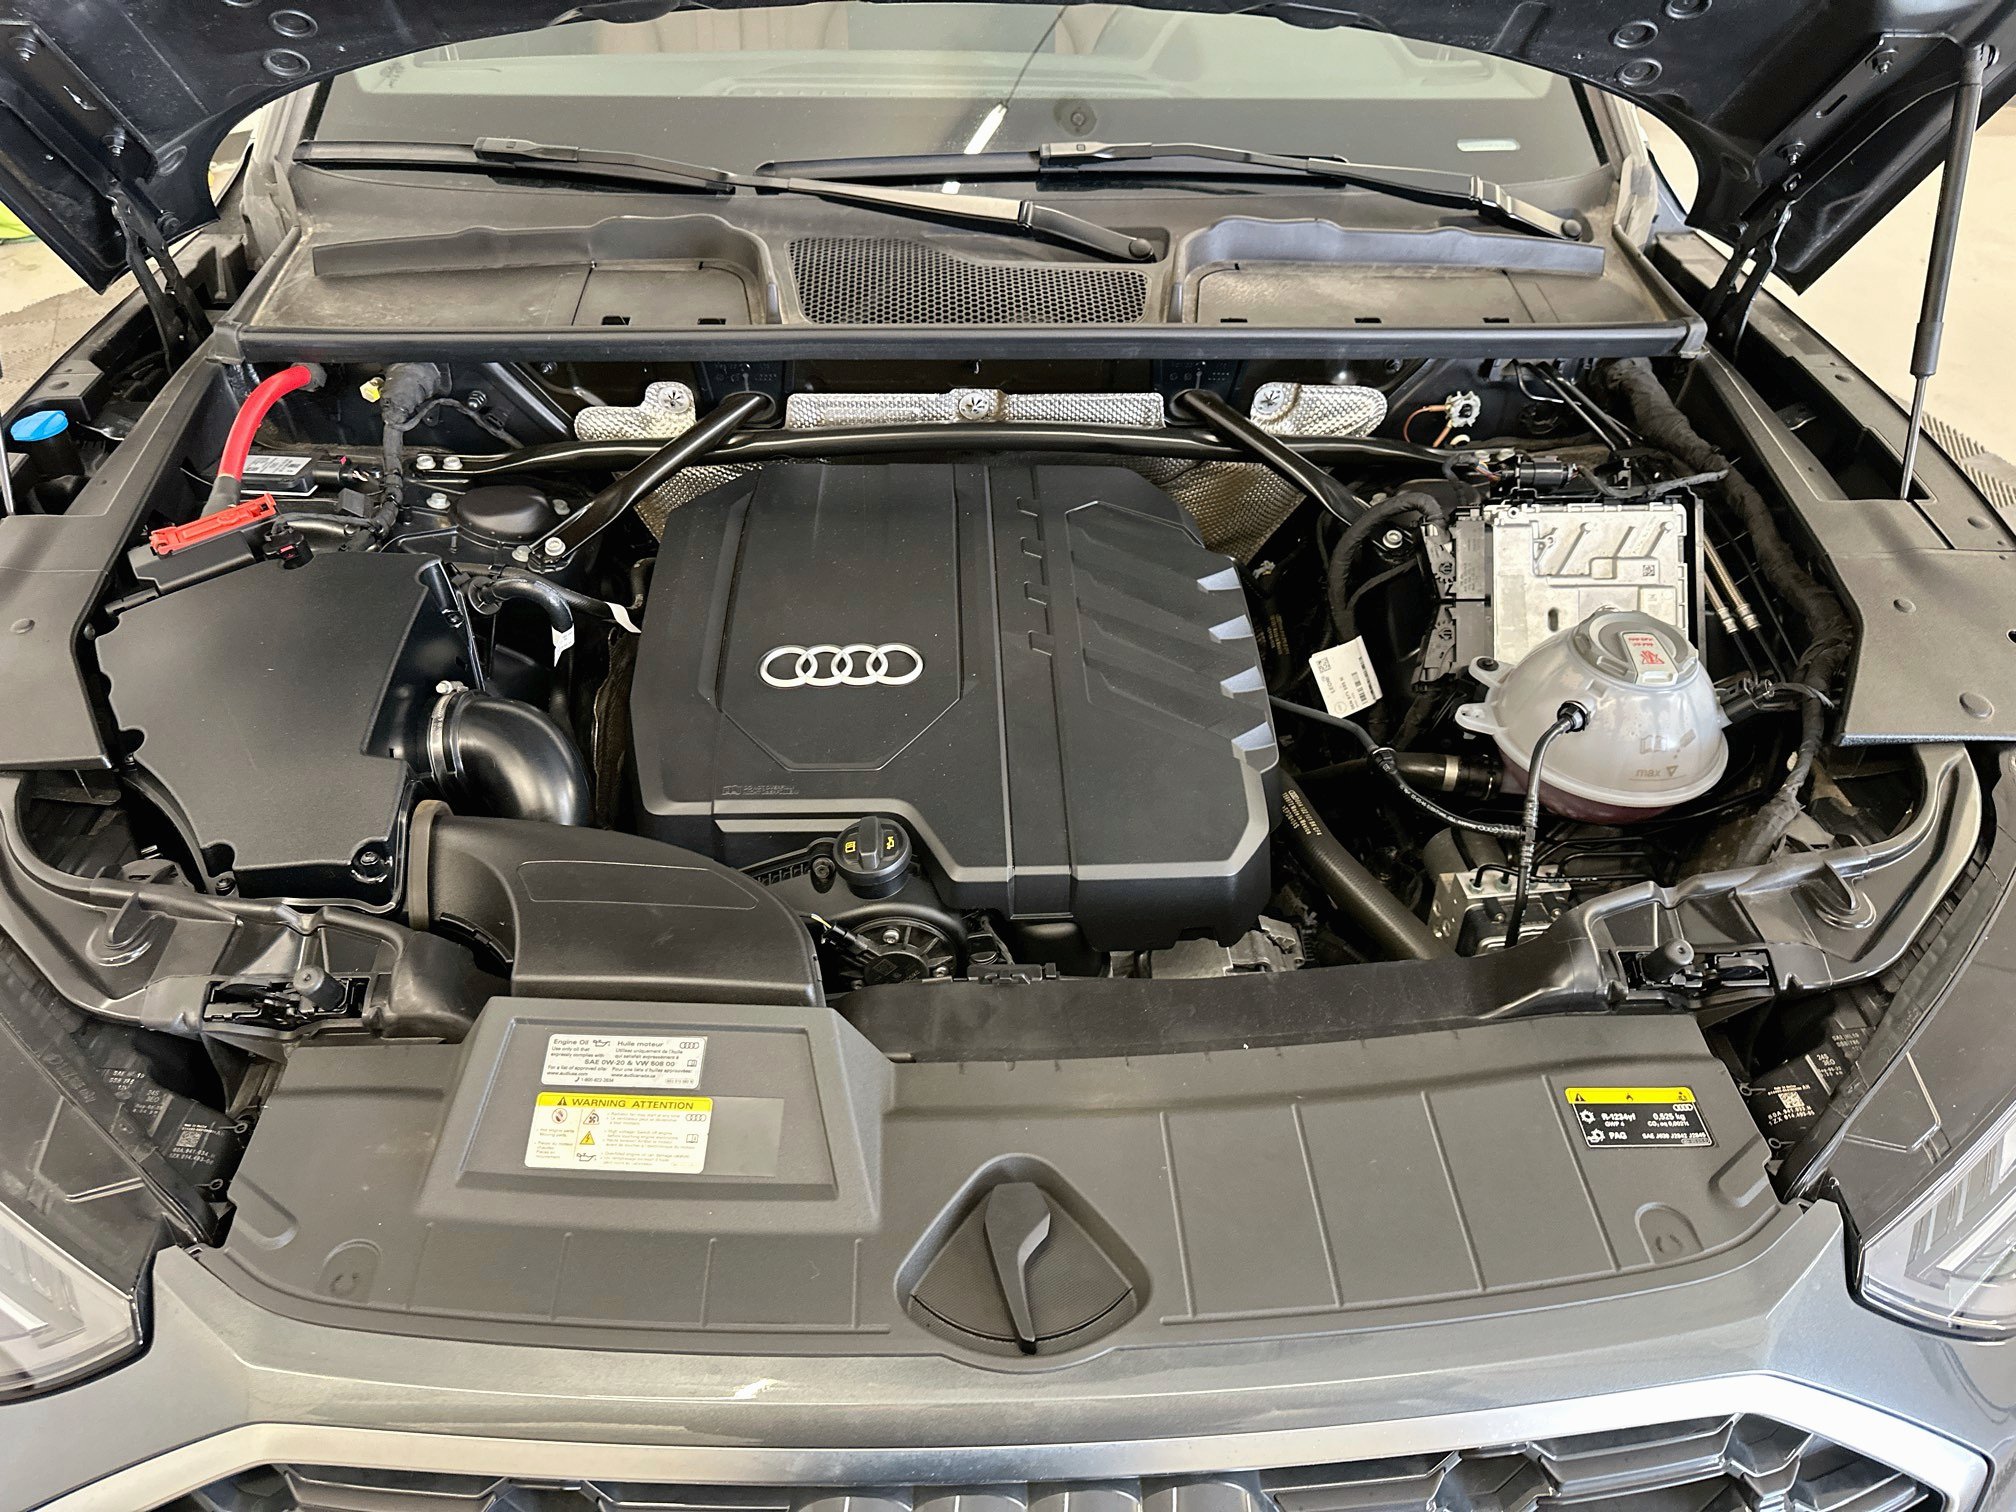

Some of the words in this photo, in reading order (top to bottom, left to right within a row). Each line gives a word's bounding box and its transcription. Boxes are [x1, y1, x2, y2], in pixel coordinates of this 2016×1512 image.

[1635, 768, 1661, 777] max
[553, 1038, 578, 1046] Engine
[584, 1058, 600, 1066] SAE
[601, 1059, 626, 1067] 0W-20
[572, 1098, 627, 1109] WARNING
[631, 1100, 695, 1110] ATTENTION
[1675, 1112, 1687, 1122] kg
[1608, 1130, 1628, 1140] PAG
